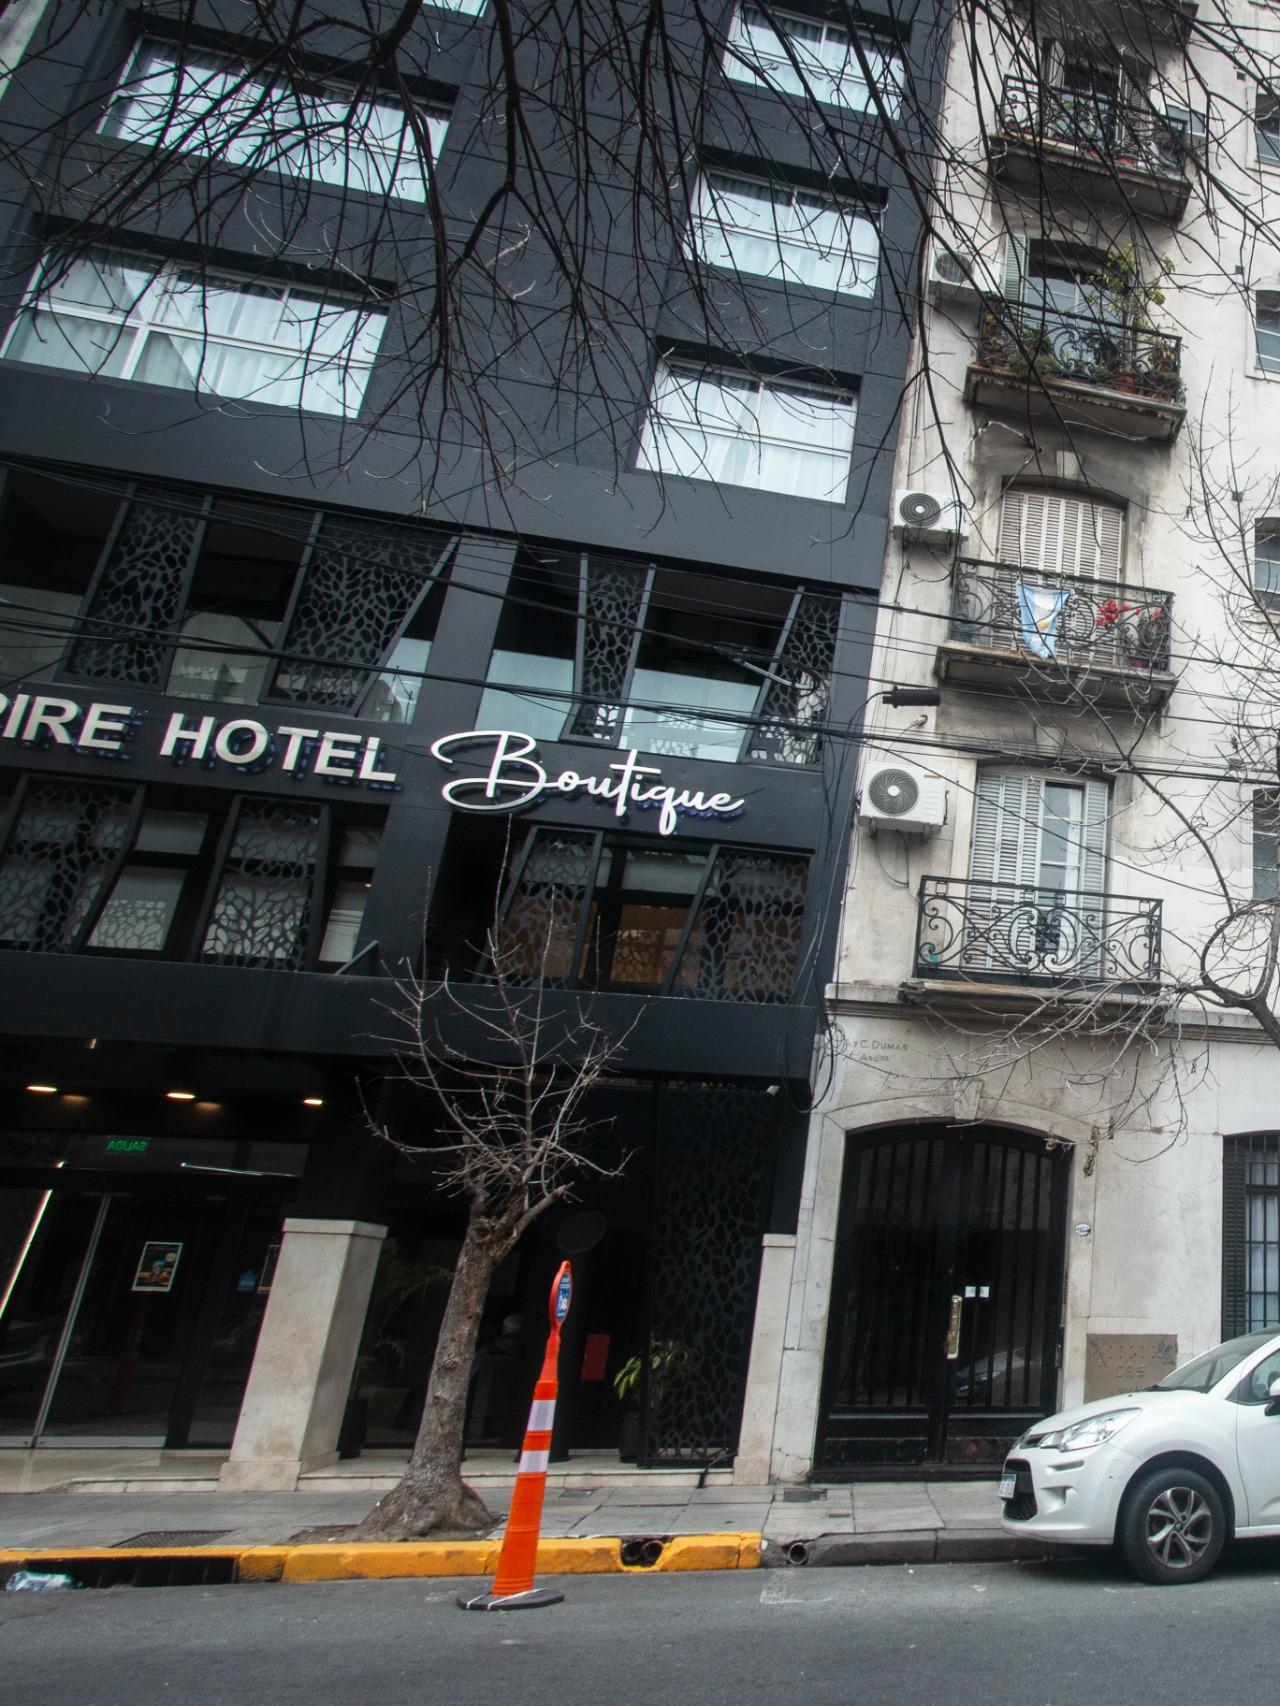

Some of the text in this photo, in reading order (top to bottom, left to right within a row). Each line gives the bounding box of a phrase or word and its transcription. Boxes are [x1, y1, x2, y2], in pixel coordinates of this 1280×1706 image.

[0, 692, 397, 783] IRE HOTEL
[430, 730, 745, 836] Boutique
[871, 1040, 909, 1051] DUMAS
